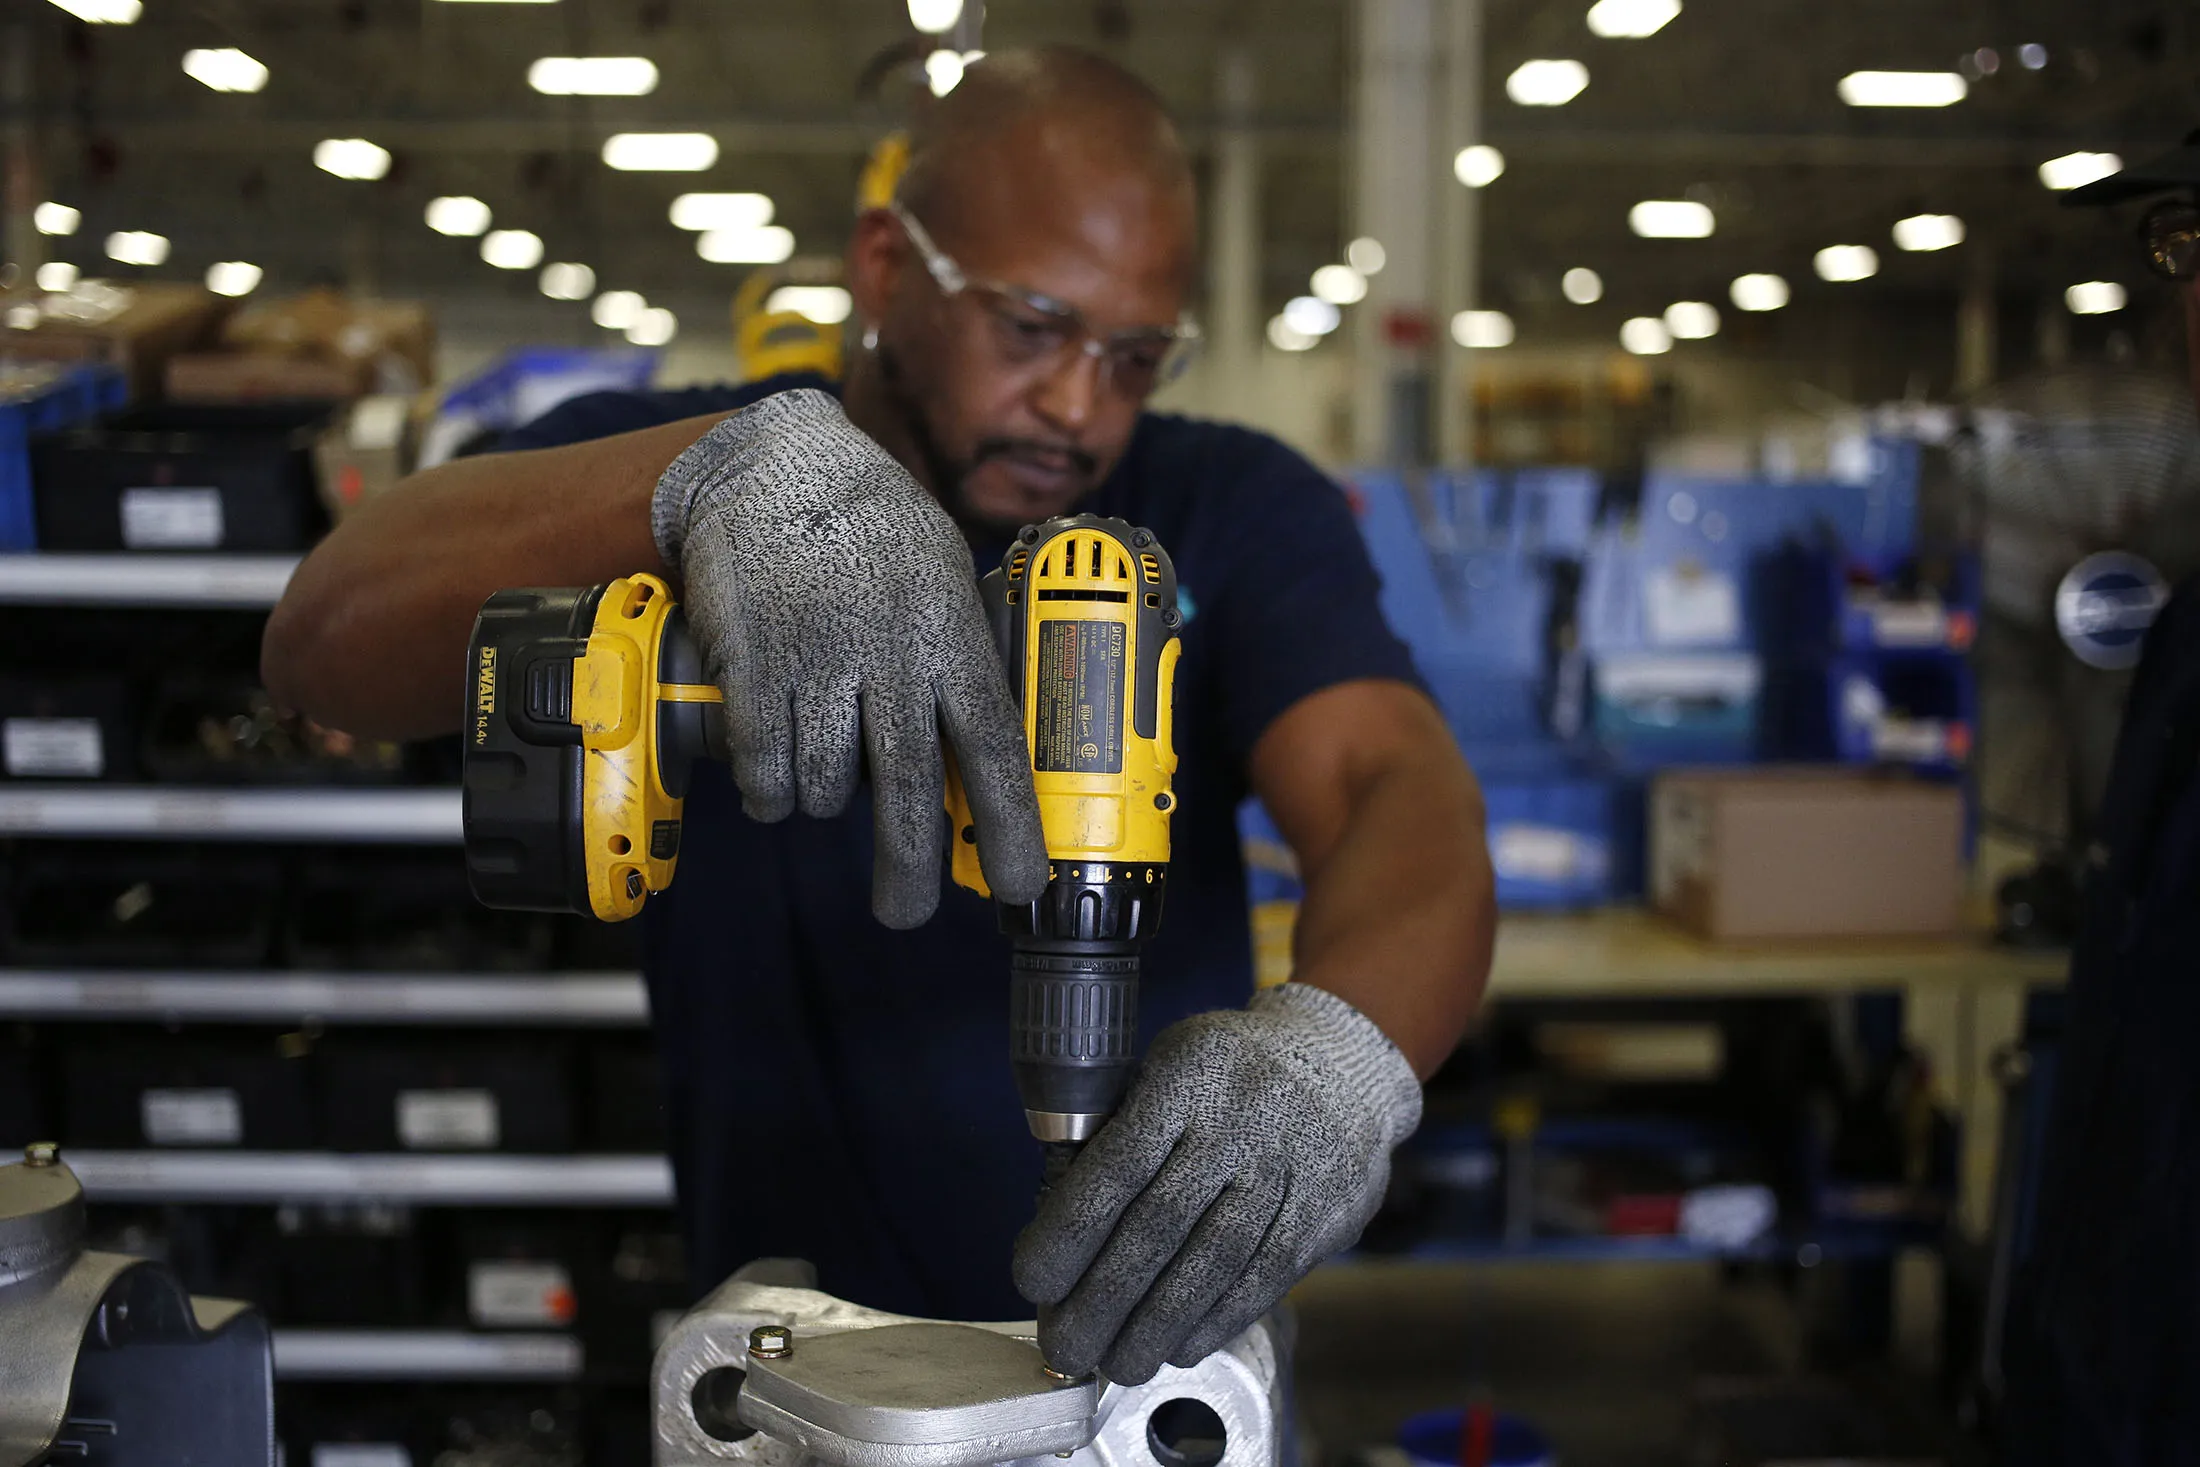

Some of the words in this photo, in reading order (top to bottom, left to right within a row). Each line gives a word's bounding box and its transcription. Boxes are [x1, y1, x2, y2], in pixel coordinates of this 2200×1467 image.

[1064, 636, 1075, 677] WARNING
[1111, 626, 1121, 657] DC730
[1081, 704, 1090, 720] NOM
